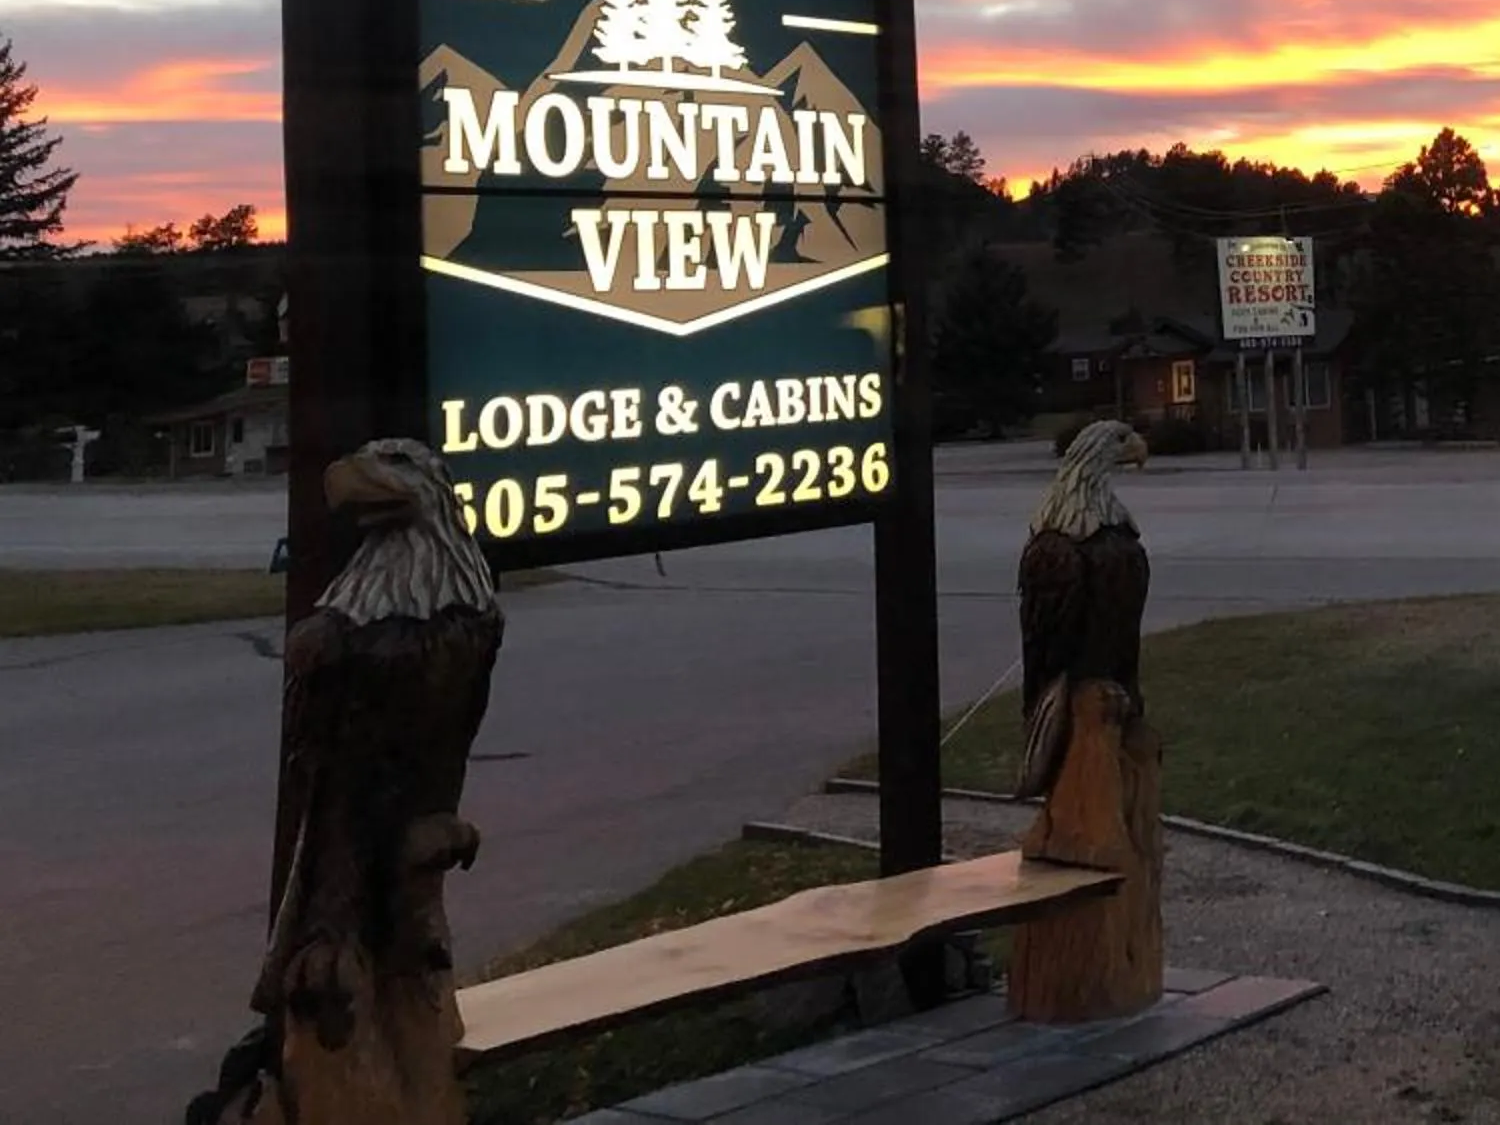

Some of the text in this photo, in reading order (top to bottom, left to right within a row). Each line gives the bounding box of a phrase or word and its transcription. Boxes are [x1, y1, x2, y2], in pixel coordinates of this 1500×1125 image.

[443, 88, 865, 186] MOUNTAIN
[571, 209, 776, 292] VIEW
[1226, 255, 1306, 267] CREEKSIDE
[1228, 284, 1309, 304] RESORT
[1230, 270, 1304, 283] COUNTRY
[442, 373, 882, 453] LODGE & CABINS
